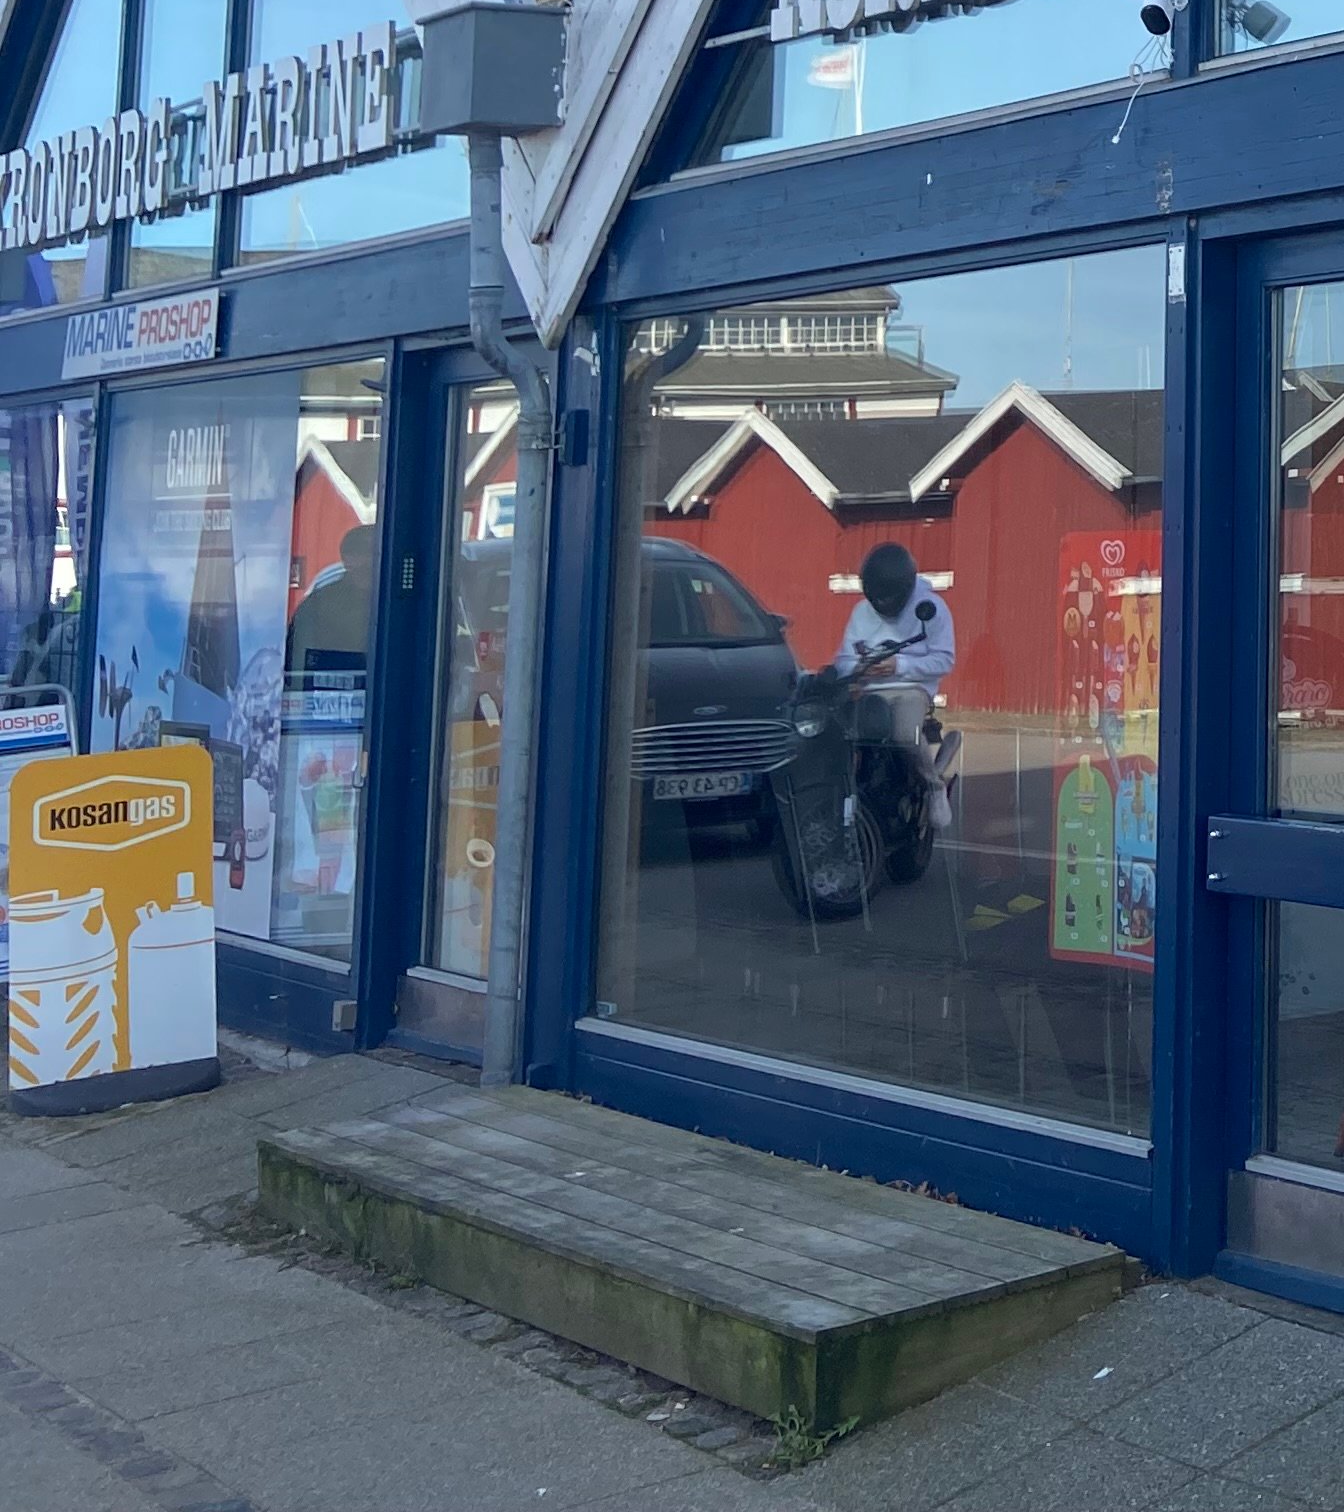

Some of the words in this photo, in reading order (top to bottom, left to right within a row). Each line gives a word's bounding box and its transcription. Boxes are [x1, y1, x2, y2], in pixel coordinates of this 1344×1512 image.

[199, 20, 397, 196] MARINE
[67, 304, 136, 358] MARINE
[138, 299, 212, 347] PROSHOP
[166, 425, 225, 488] GARMIN
[0, 712, 59, 731] OSHOP
[50, 794, 176, 831] Kosangas
